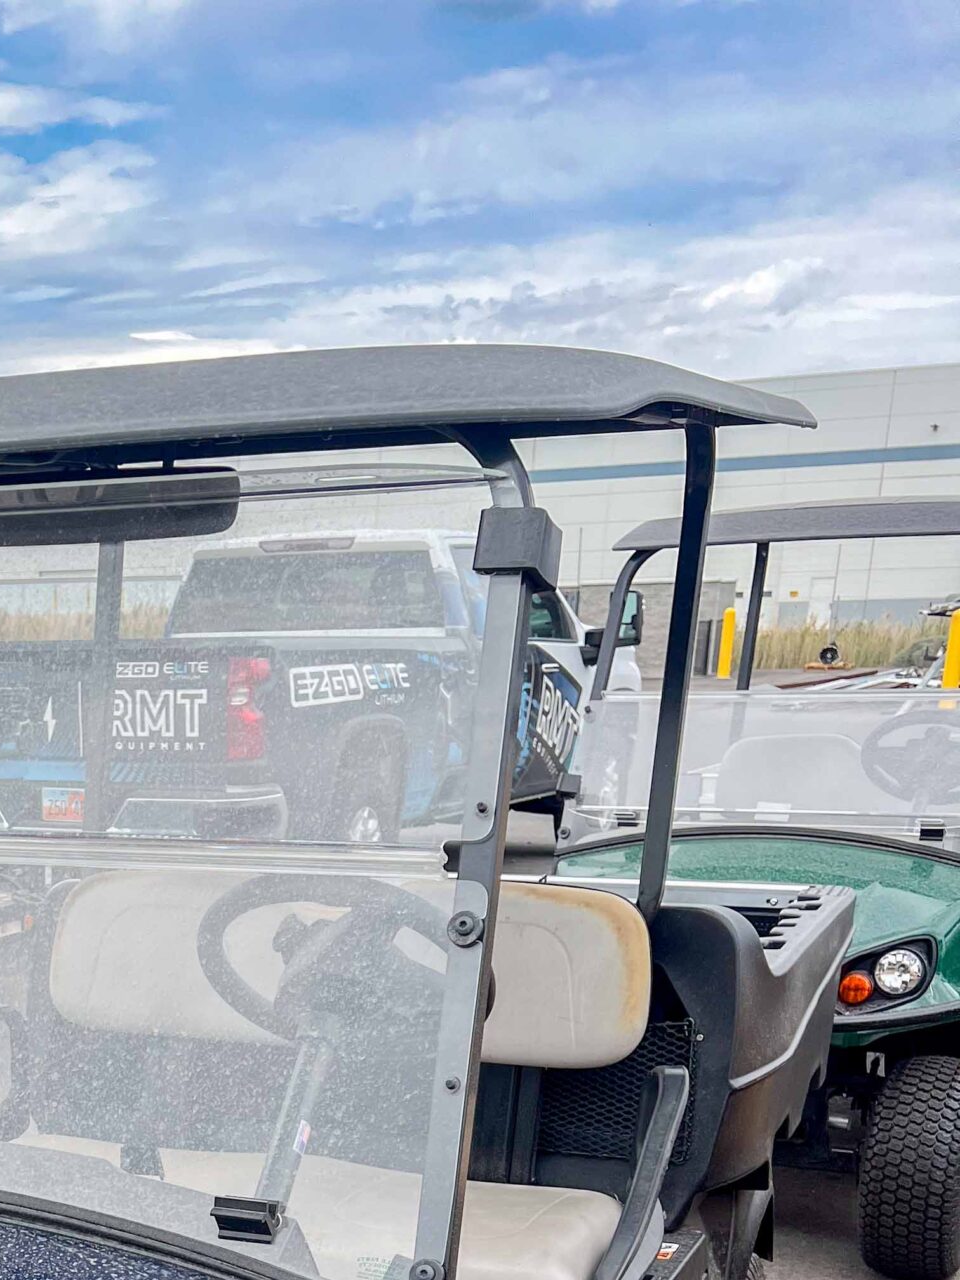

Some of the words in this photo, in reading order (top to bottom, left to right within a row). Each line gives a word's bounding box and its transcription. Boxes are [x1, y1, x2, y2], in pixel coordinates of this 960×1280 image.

[116, 662, 159, 678] ZGO
[163, 662, 209, 674] ELITE
[362, 662, 410, 690] ELITE
[112, 689, 208, 738] RMT
[536, 673, 581, 765] RMT
[114, 741, 206, 751] QUIPMENT
